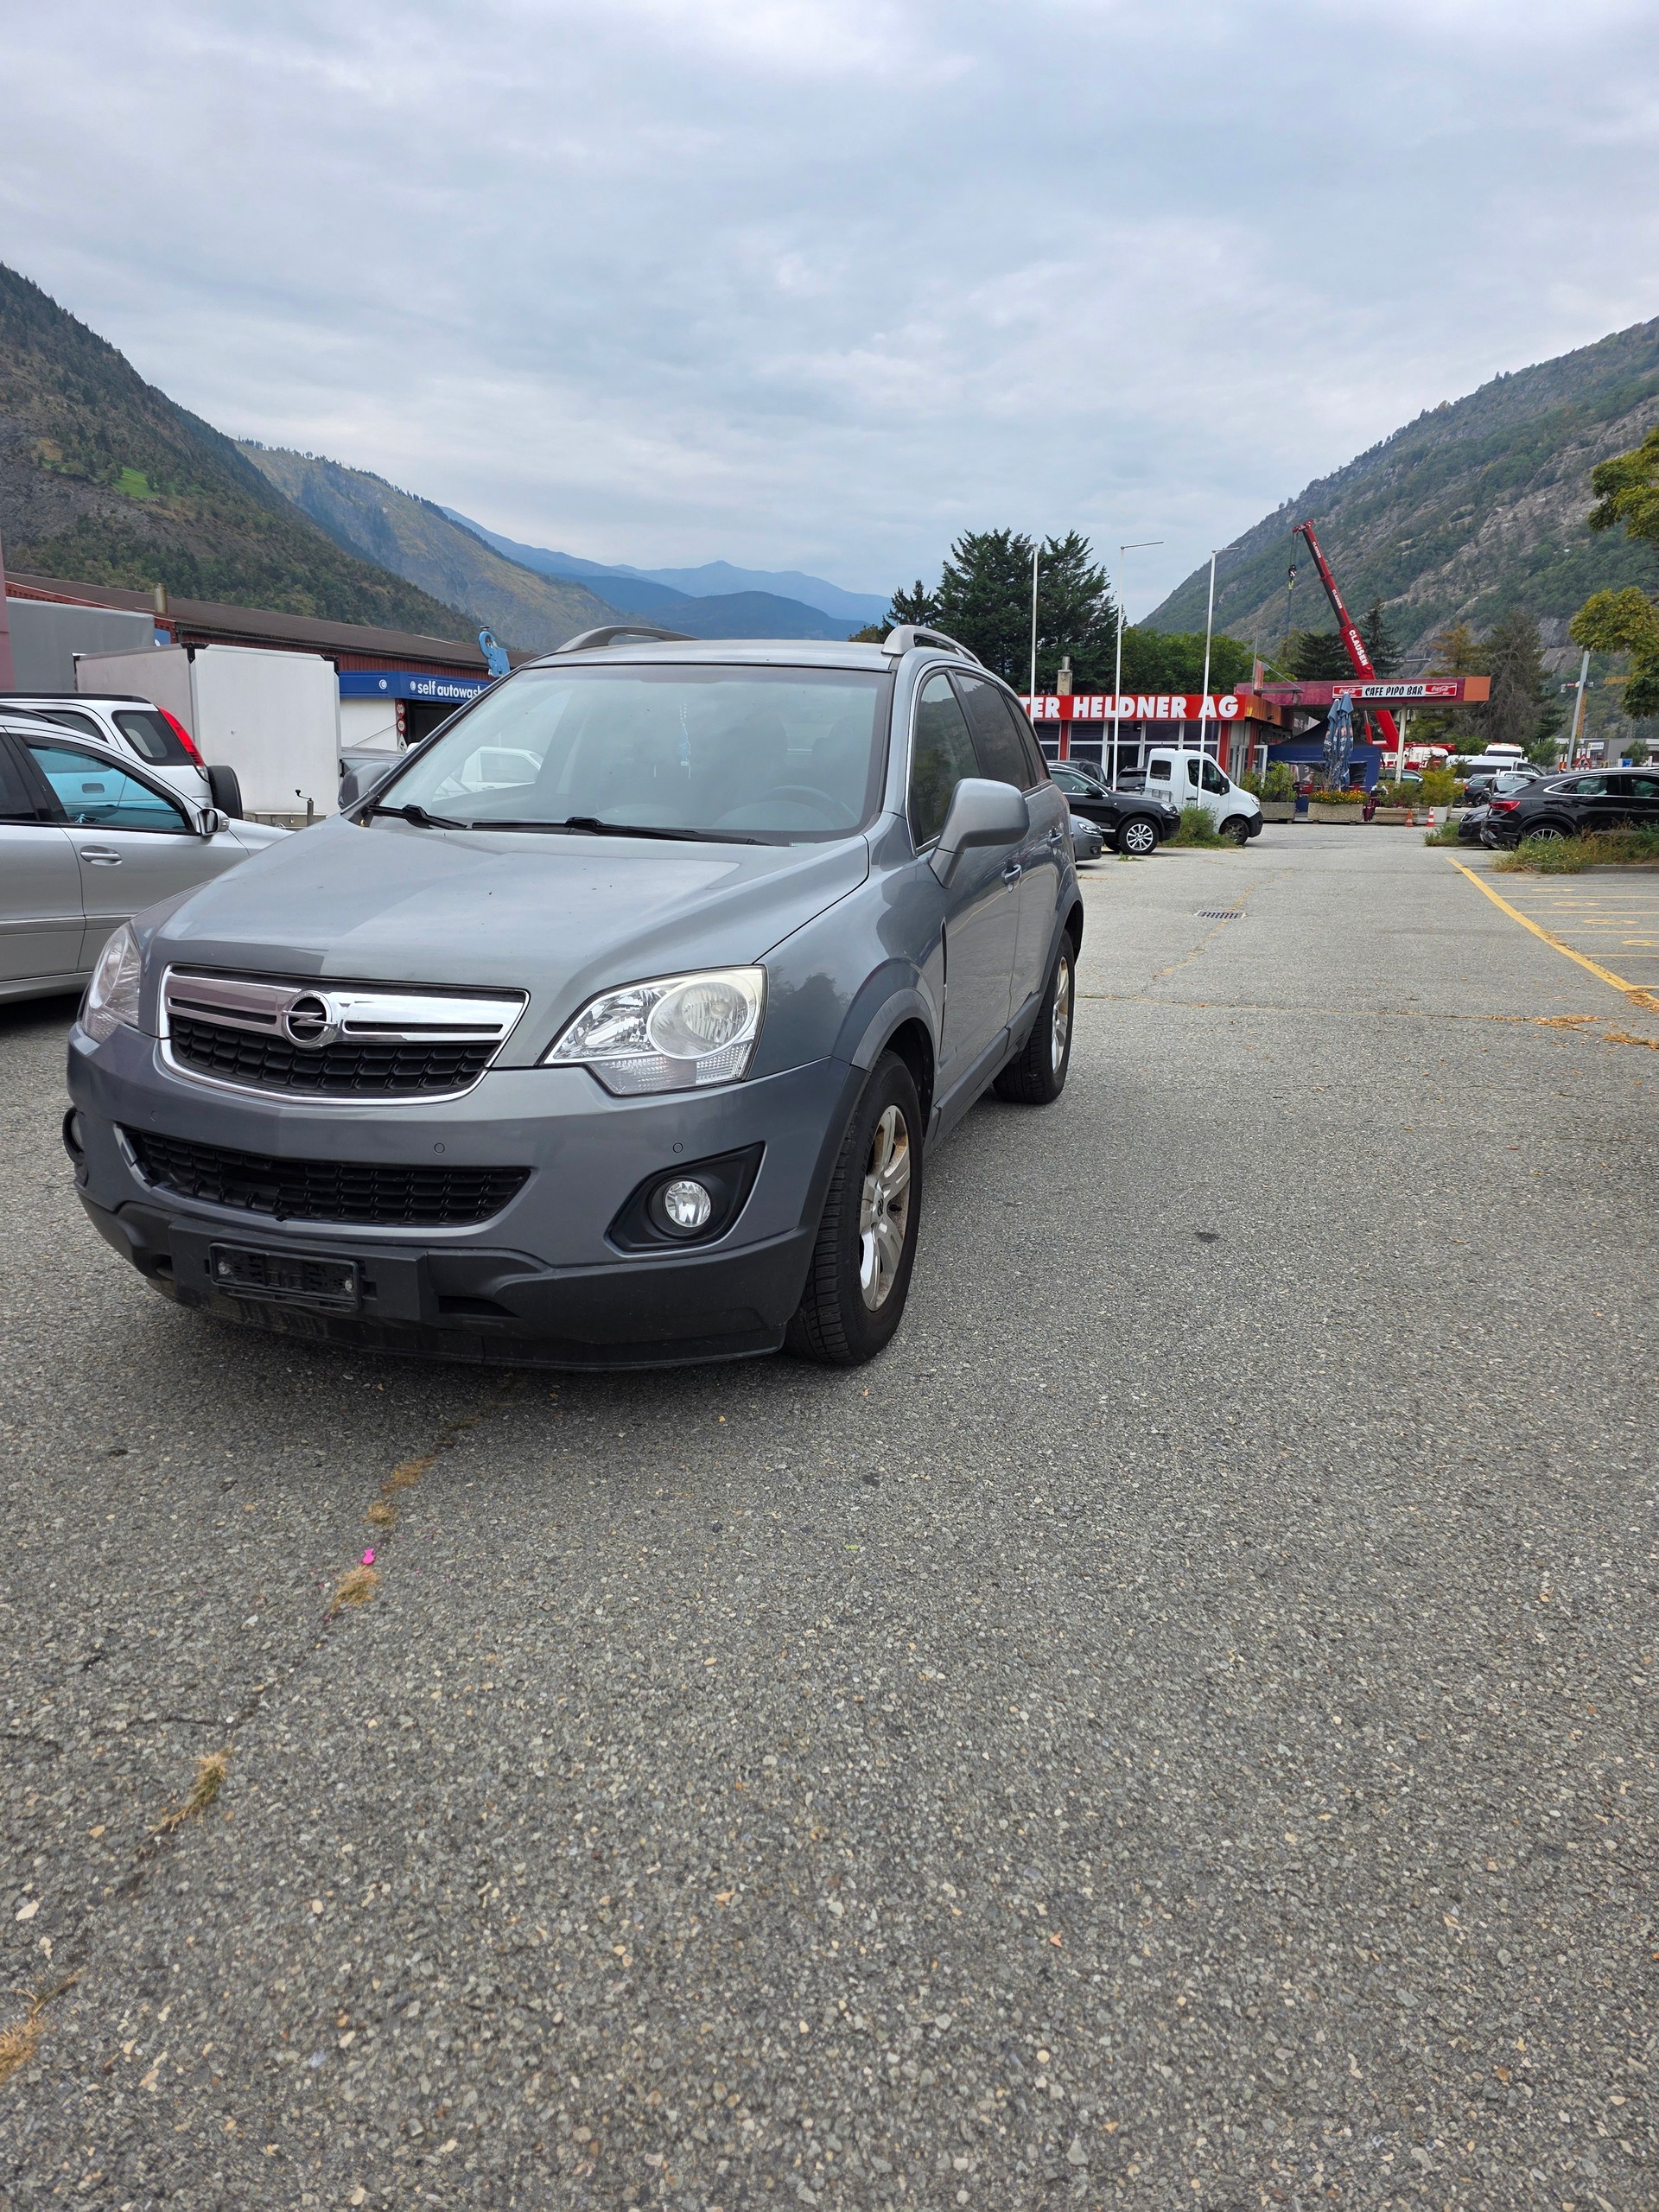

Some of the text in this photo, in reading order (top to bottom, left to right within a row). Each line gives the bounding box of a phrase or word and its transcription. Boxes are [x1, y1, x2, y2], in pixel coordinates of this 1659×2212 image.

[1349, 629, 1370, 667] CLAUSEN
[417, 680, 436, 696] self
[1365, 685, 1424, 696] CAFE PIPO BAR
[1072, 696, 1187, 718] HELDNER
[1198, 695, 1239, 718] AG
